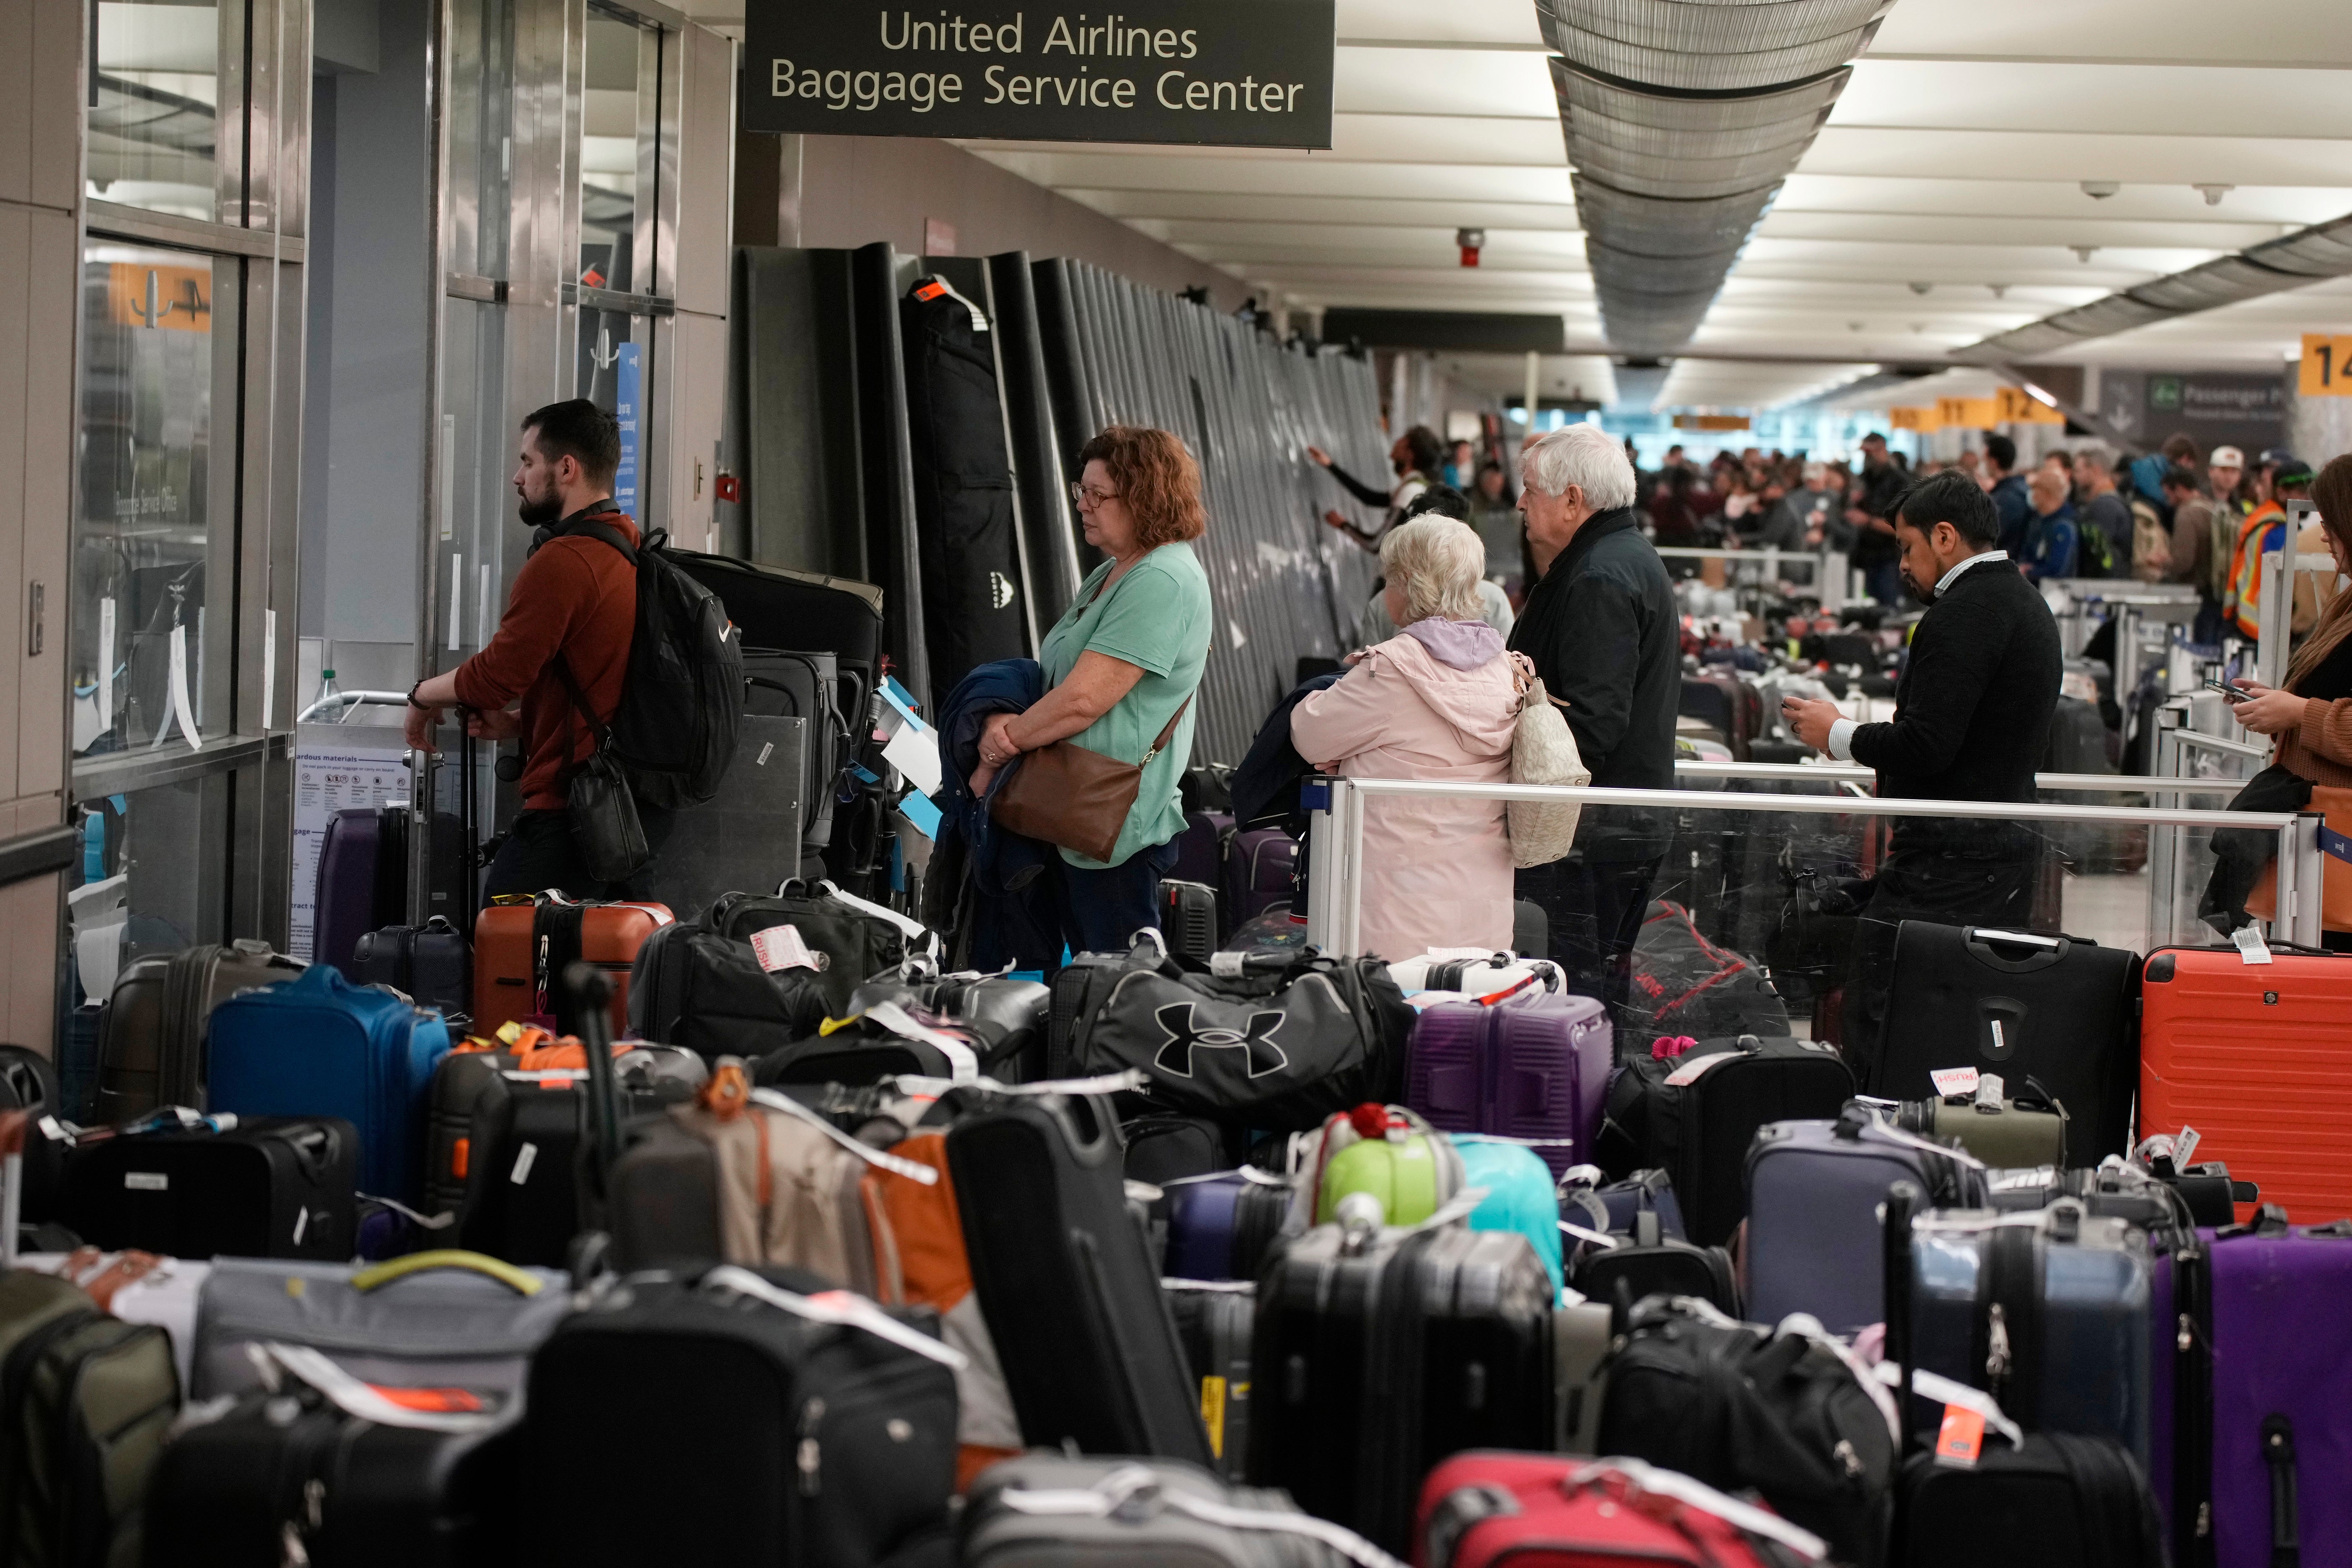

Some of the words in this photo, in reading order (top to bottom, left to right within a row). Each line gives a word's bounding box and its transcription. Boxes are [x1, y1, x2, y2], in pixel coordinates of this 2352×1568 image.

[881, 11, 1022, 53] United
[1042, 15, 1197, 59] Airlines
[772, 59, 962, 113] Baggage
[984, 65, 1135, 108] Service
[1157, 70, 1304, 112] Center
[141, 488, 160, 514] Service
[162, 485, 177, 513] Office
[754, 937, 770, 969] RUSH
[1938, 1073, 1973, 1083] RUSH
